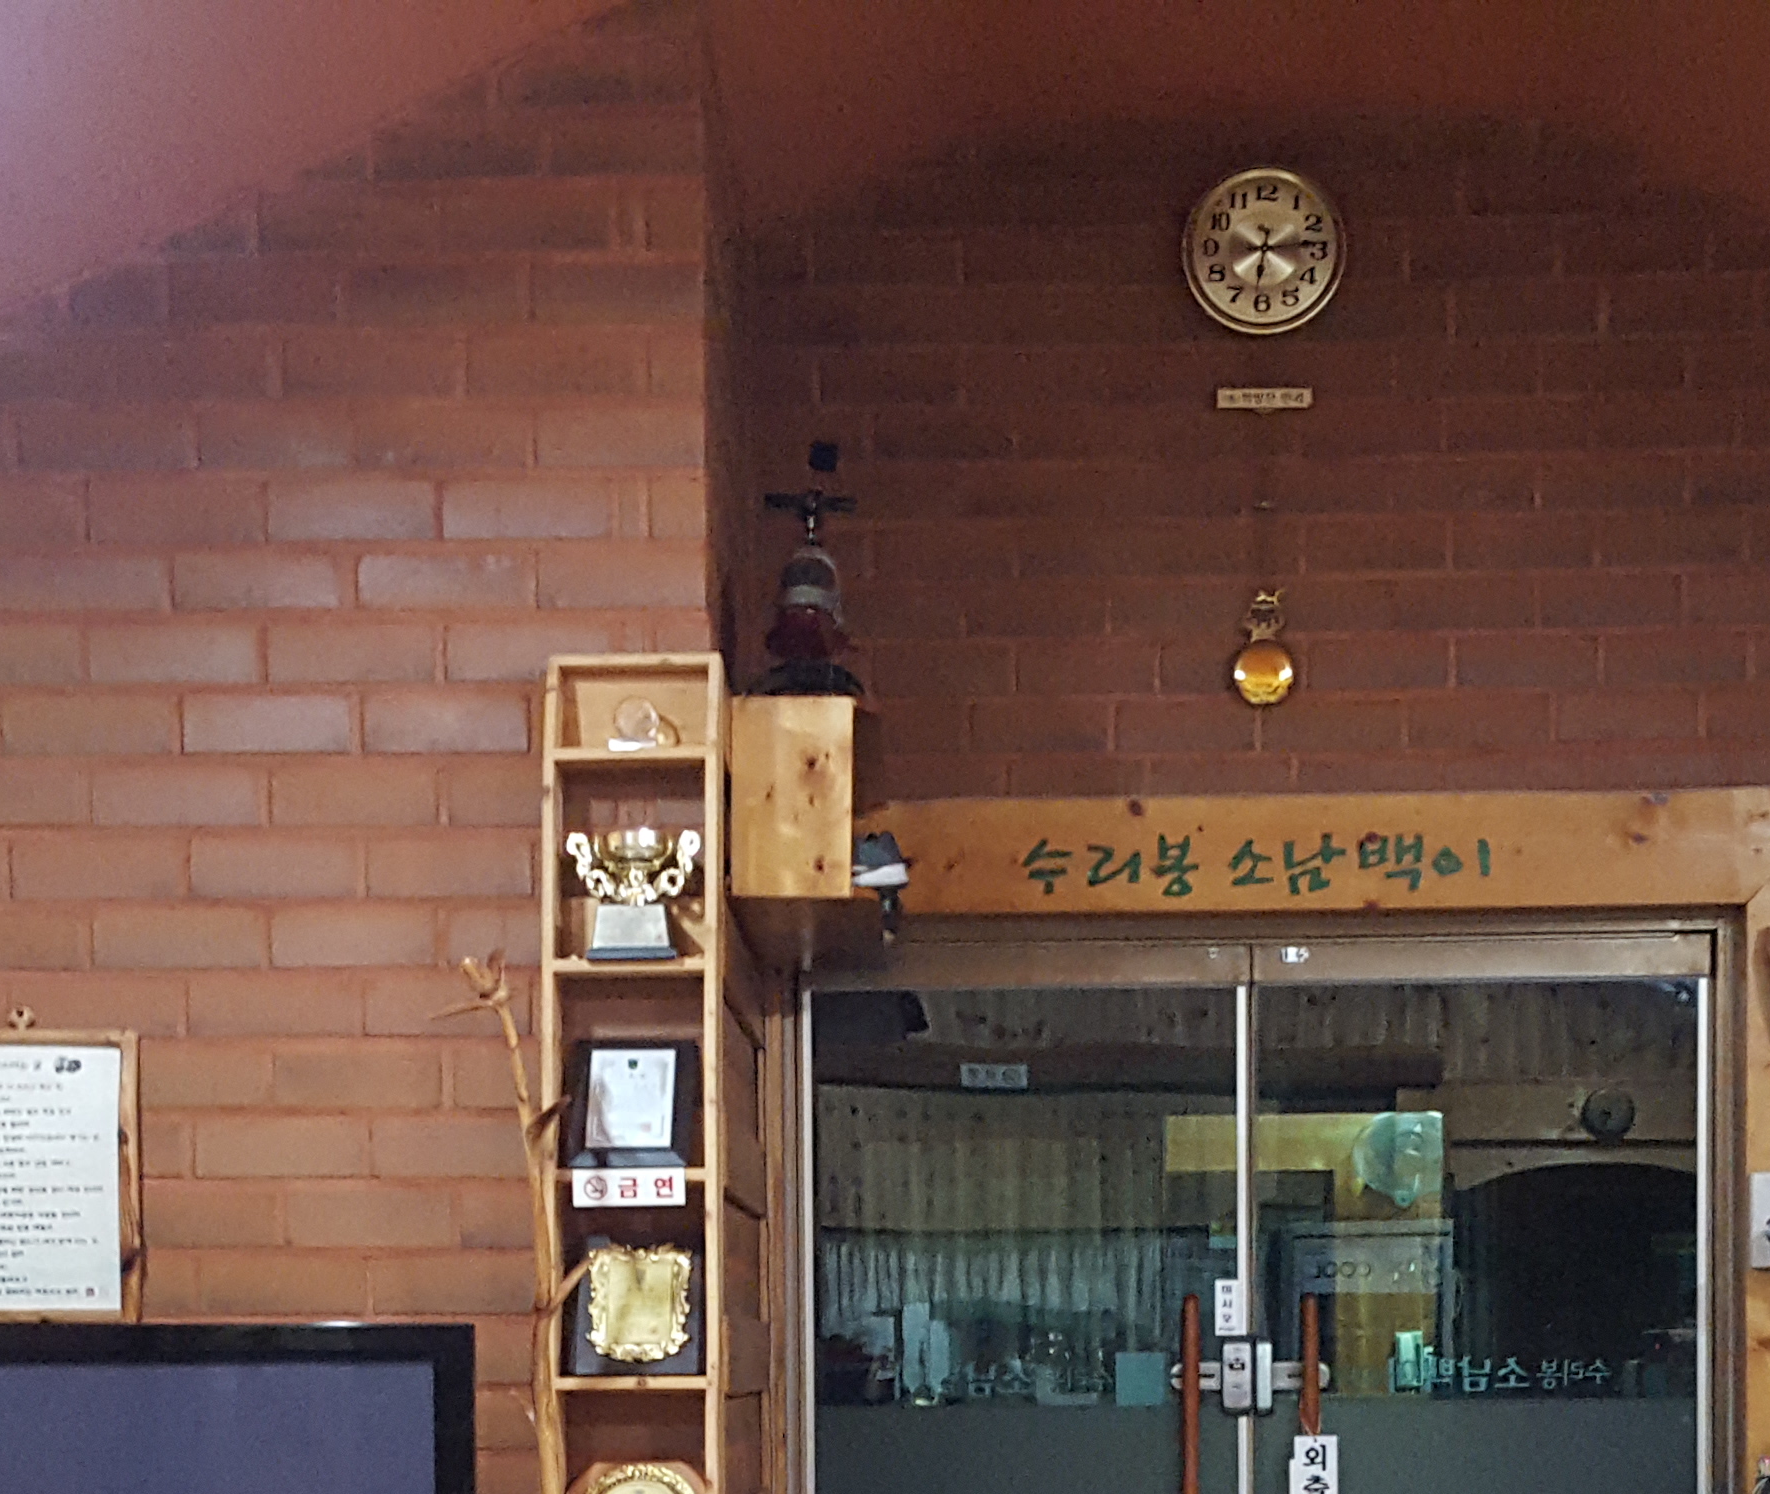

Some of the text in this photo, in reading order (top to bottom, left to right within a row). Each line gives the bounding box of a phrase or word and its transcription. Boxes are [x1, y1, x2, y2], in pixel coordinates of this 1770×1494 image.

[1229, 192, 1248, 209] 11
[1256, 183, 1279, 202] 12
[1292, 194, 1300, 210] 1
[1211, 212, 1230, 231] 10
[1304, 214, 1323, 232] 2
[1309, 240, 1328, 261] 3
[1208, 263, 1226, 282] 8
[1300, 266, 1317, 285] 4
[1227, 285, 1243, 303] 7
[1253, 294, 1271, 313] 6
[1281, 286, 1300, 307] 5
[1022, 832, 1491, 898] 수리봉 소남백이
